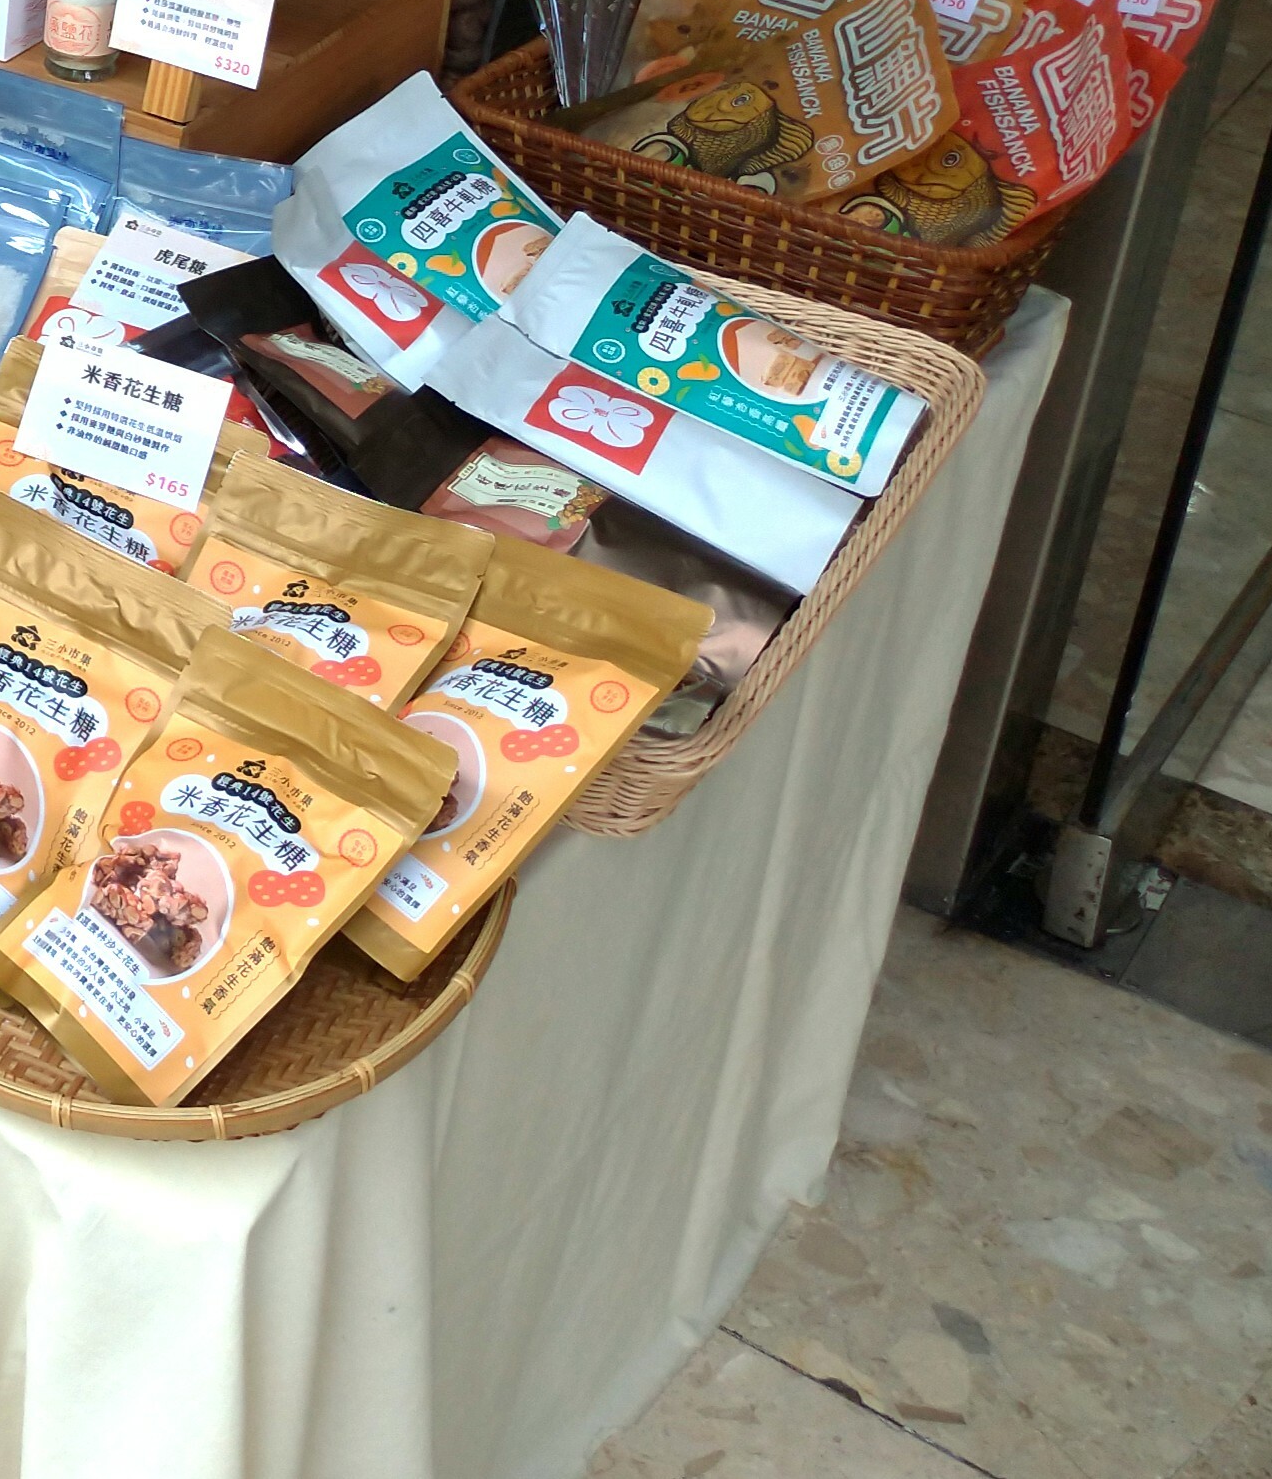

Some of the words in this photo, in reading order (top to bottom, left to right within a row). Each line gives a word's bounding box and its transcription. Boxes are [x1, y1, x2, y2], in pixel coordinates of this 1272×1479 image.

[215, 56, 251, 77] $320
[802, 28, 835, 83] BANANA
[994, 65, 1042, 136] BANANA
[977, 79, 1037, 177] FISHSANCK
[409, 177, 498, 244] 四喜牛軋糖
[153, 248, 208, 276] 虎尾糖
[81, 363, 185, 413] 米香花生糖
[145, 472, 190, 498] $165
[46, 638, 94, 669] 三小市集
[13, 718, 38, 738] 2012
[214, 773, 298, 834] 經典14號花生
[270, 765, 315, 809] 三小市集
[169, 783, 312, 874] 米香花生糖
[213, 830, 238, 851] 2012
[462, 789, 535, 867] 飽滿花生香氣
[198, 934, 277, 1017] 飽滿花生香氣
